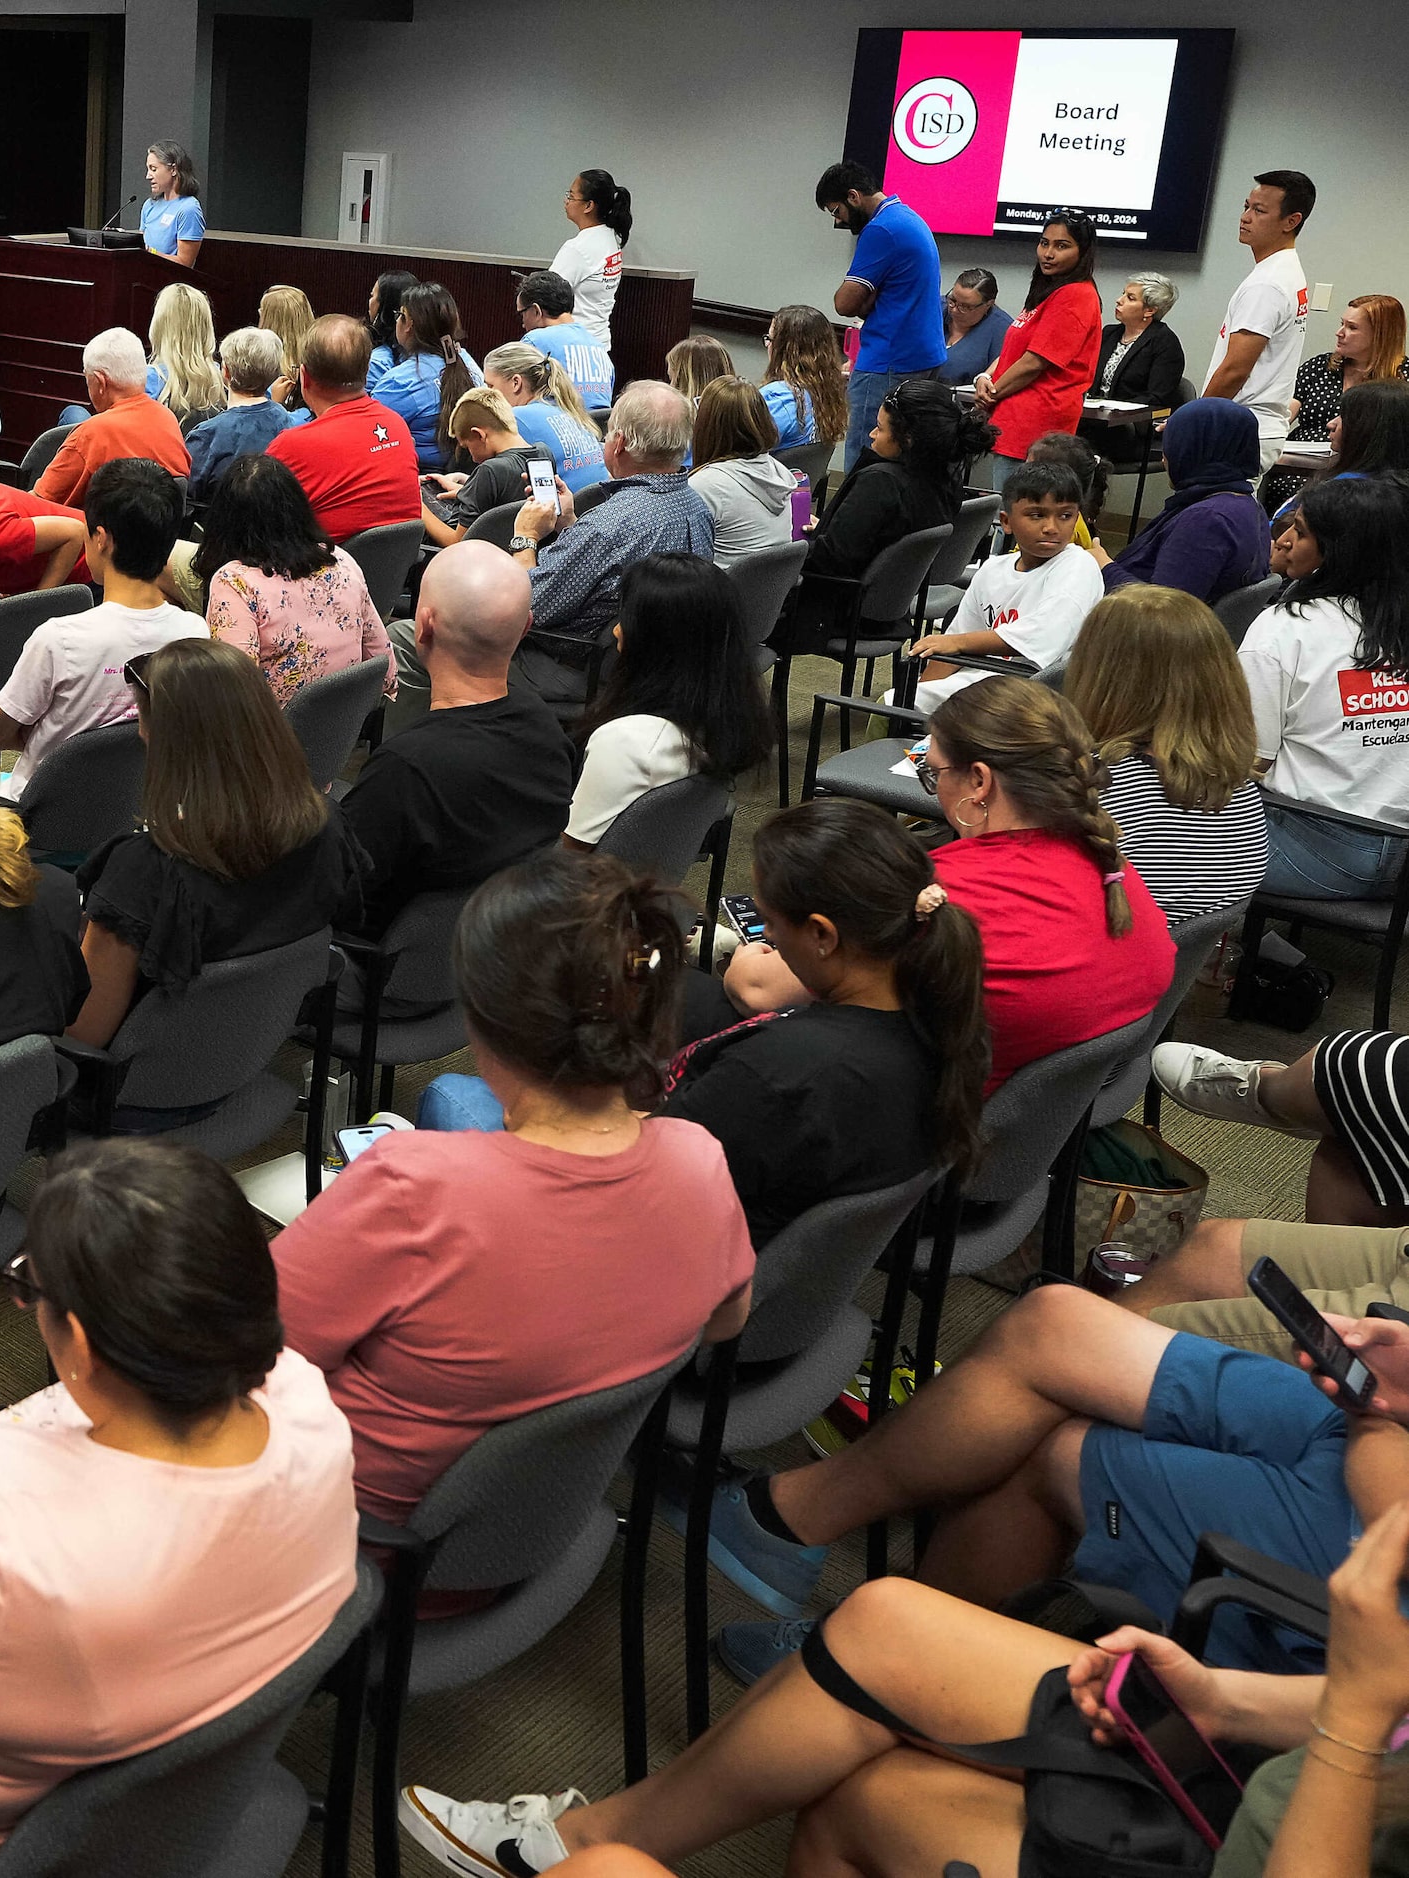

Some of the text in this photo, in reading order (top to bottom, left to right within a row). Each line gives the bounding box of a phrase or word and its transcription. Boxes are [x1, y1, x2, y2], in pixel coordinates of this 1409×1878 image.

[1055, 102, 1119, 120] Board
[1039, 132, 1127, 156] Meeting
[1006, 208, 1044, 221] Monday,
[1096, 214, 1111, 224] 30,
[1113, 214, 1137, 225] 2024
